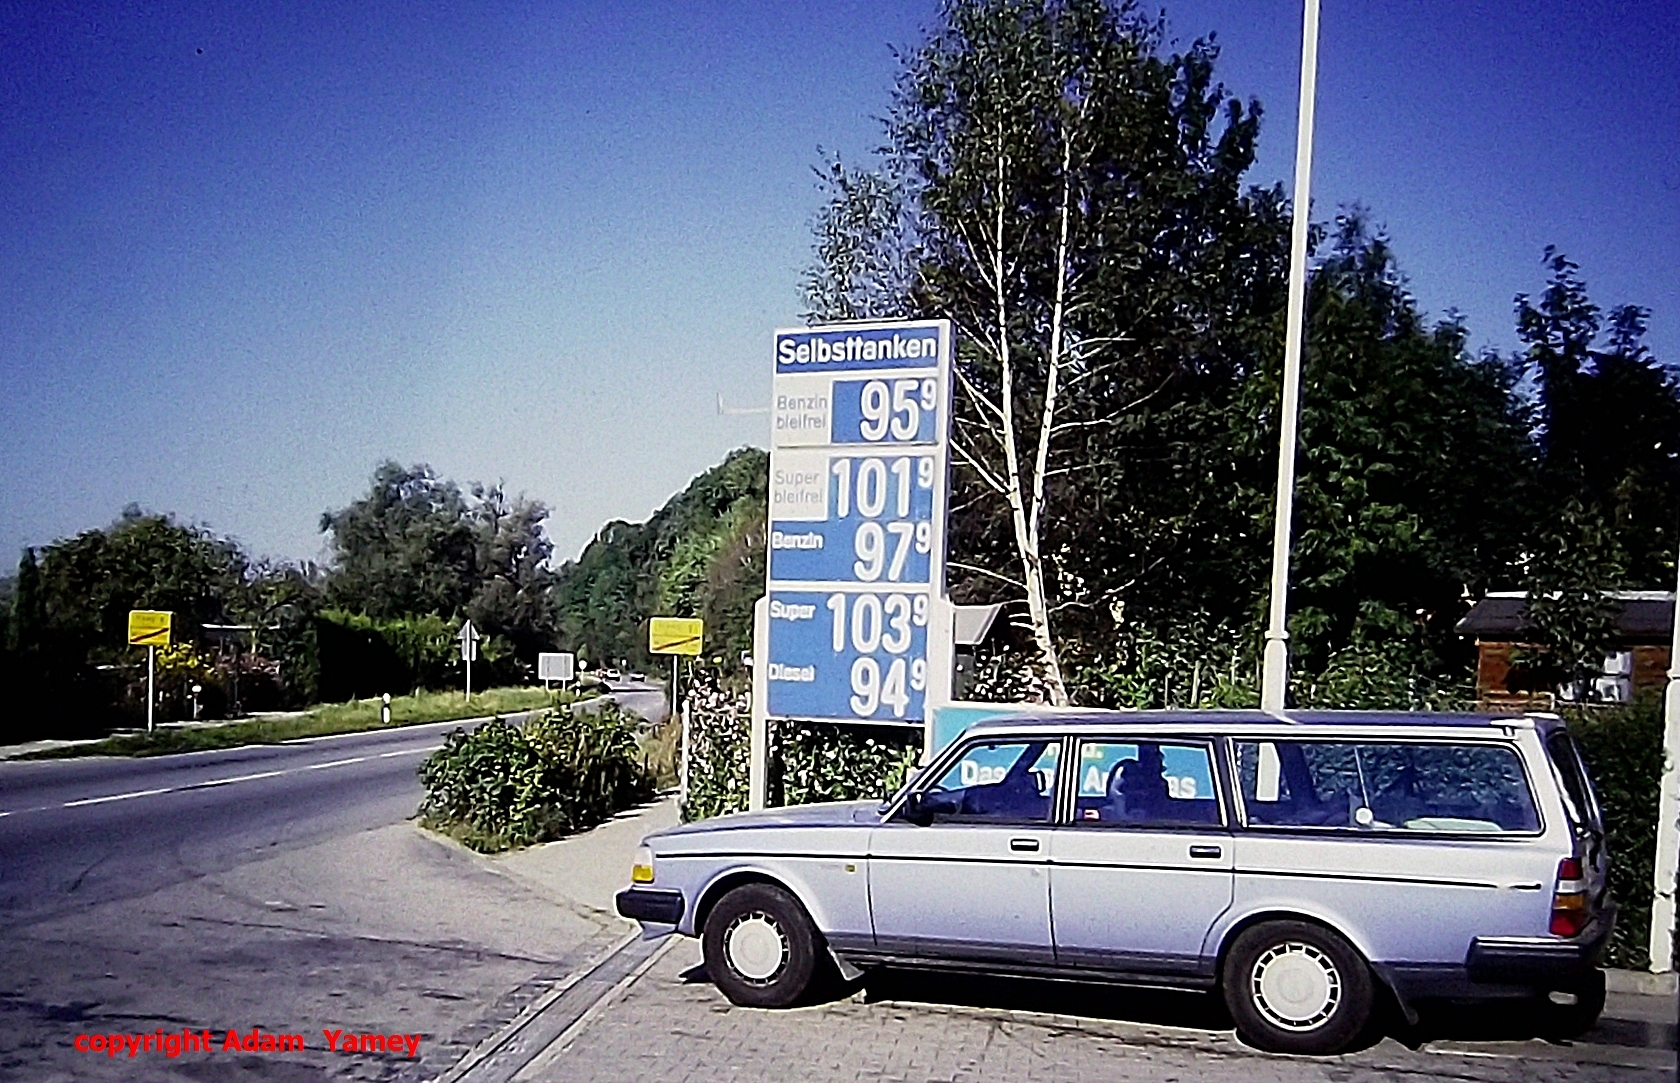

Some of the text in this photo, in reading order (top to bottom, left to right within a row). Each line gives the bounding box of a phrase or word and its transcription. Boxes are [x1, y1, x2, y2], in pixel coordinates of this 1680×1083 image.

[779, 334, 937, 365] Selbsttanken
[777, 394, 828, 411] Benzin
[776, 412, 827, 430] bleifrei
[774, 469, 820, 487] Super
[774, 488, 823, 504] bleifrei
[771, 531, 824, 549] Benzin
[769, 599, 817, 621] Super
[767, 662, 816, 682] Diesel
